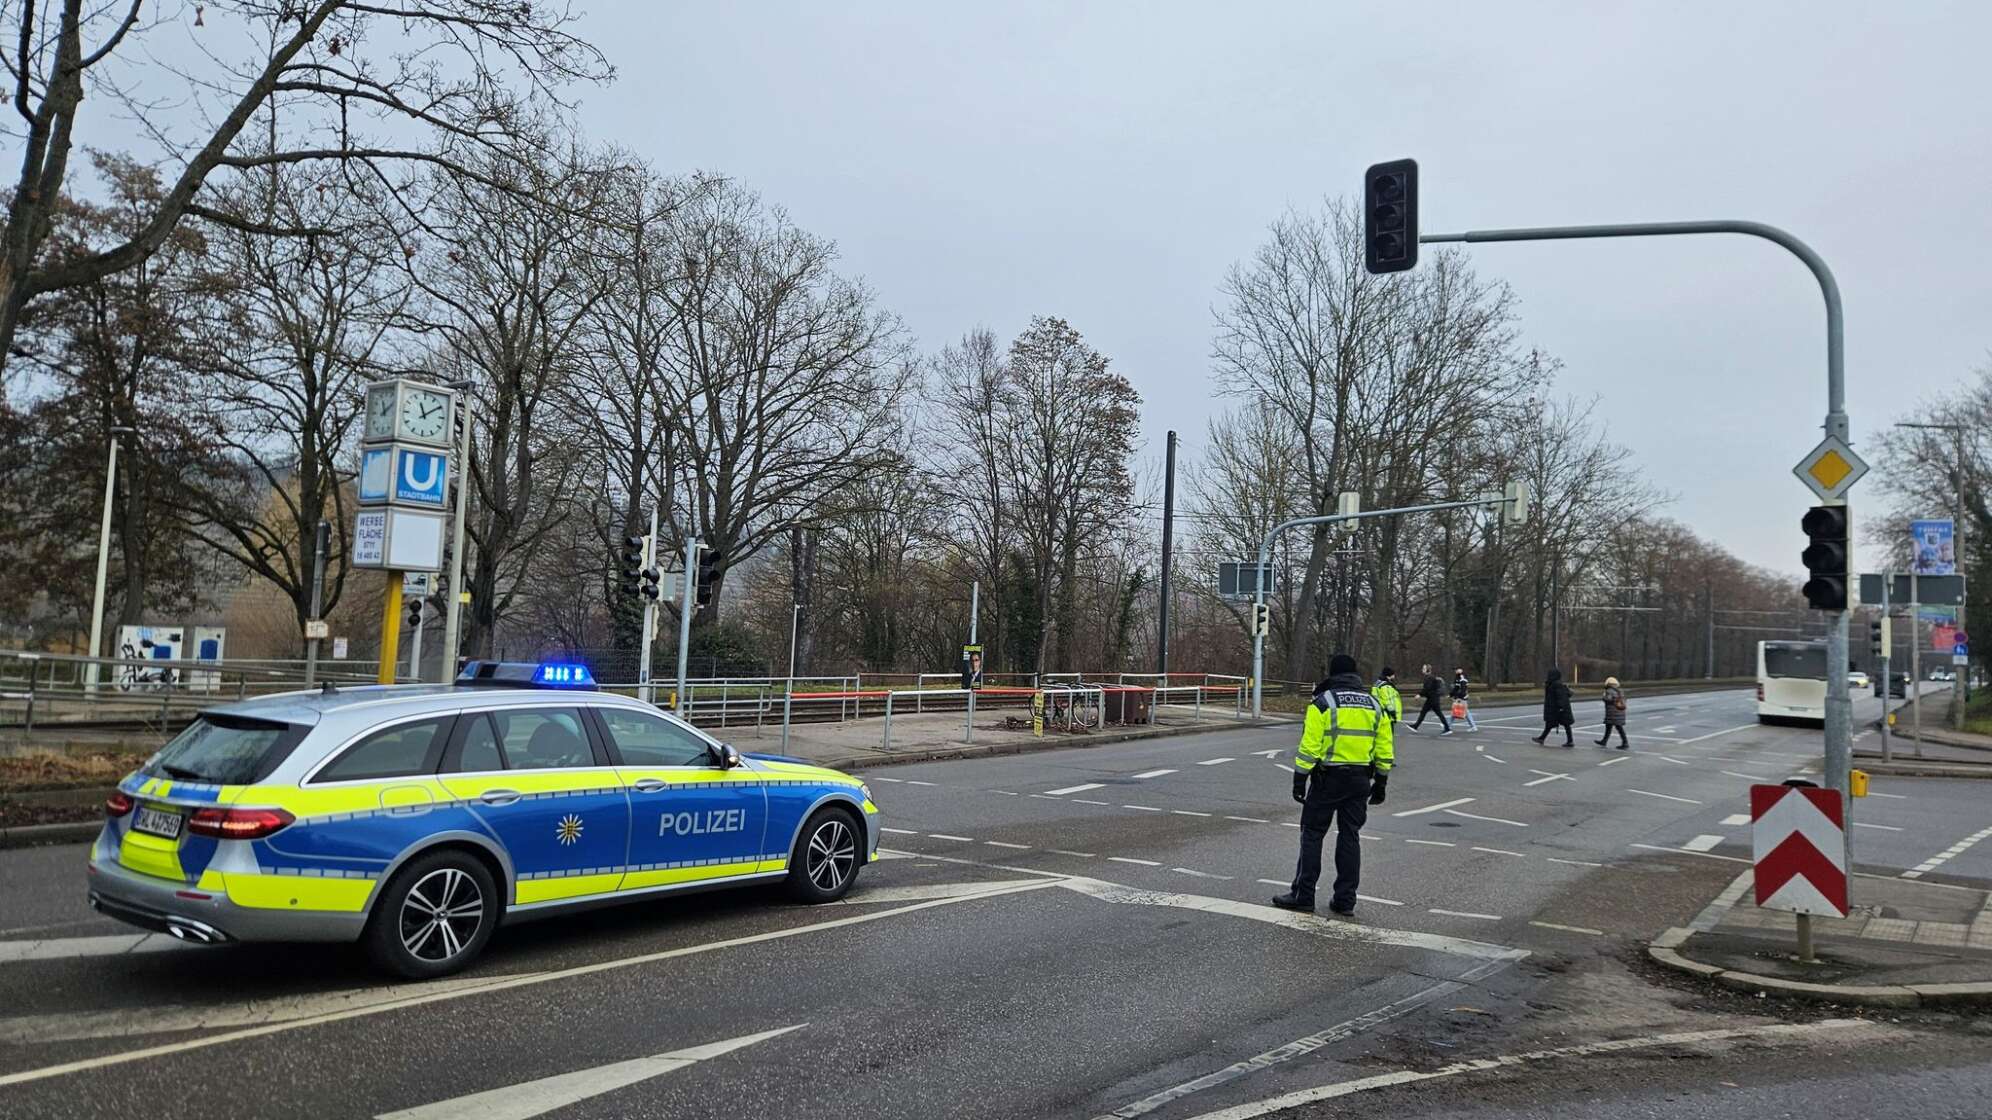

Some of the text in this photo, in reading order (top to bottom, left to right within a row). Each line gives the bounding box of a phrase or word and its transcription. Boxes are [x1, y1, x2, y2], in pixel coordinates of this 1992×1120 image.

[405, 453, 438, 490] U
[360, 516, 384, 526] WERBE
[1338, 695, 1370, 704] POLIZEI
[658, 808, 746, 837] POLIZEI
